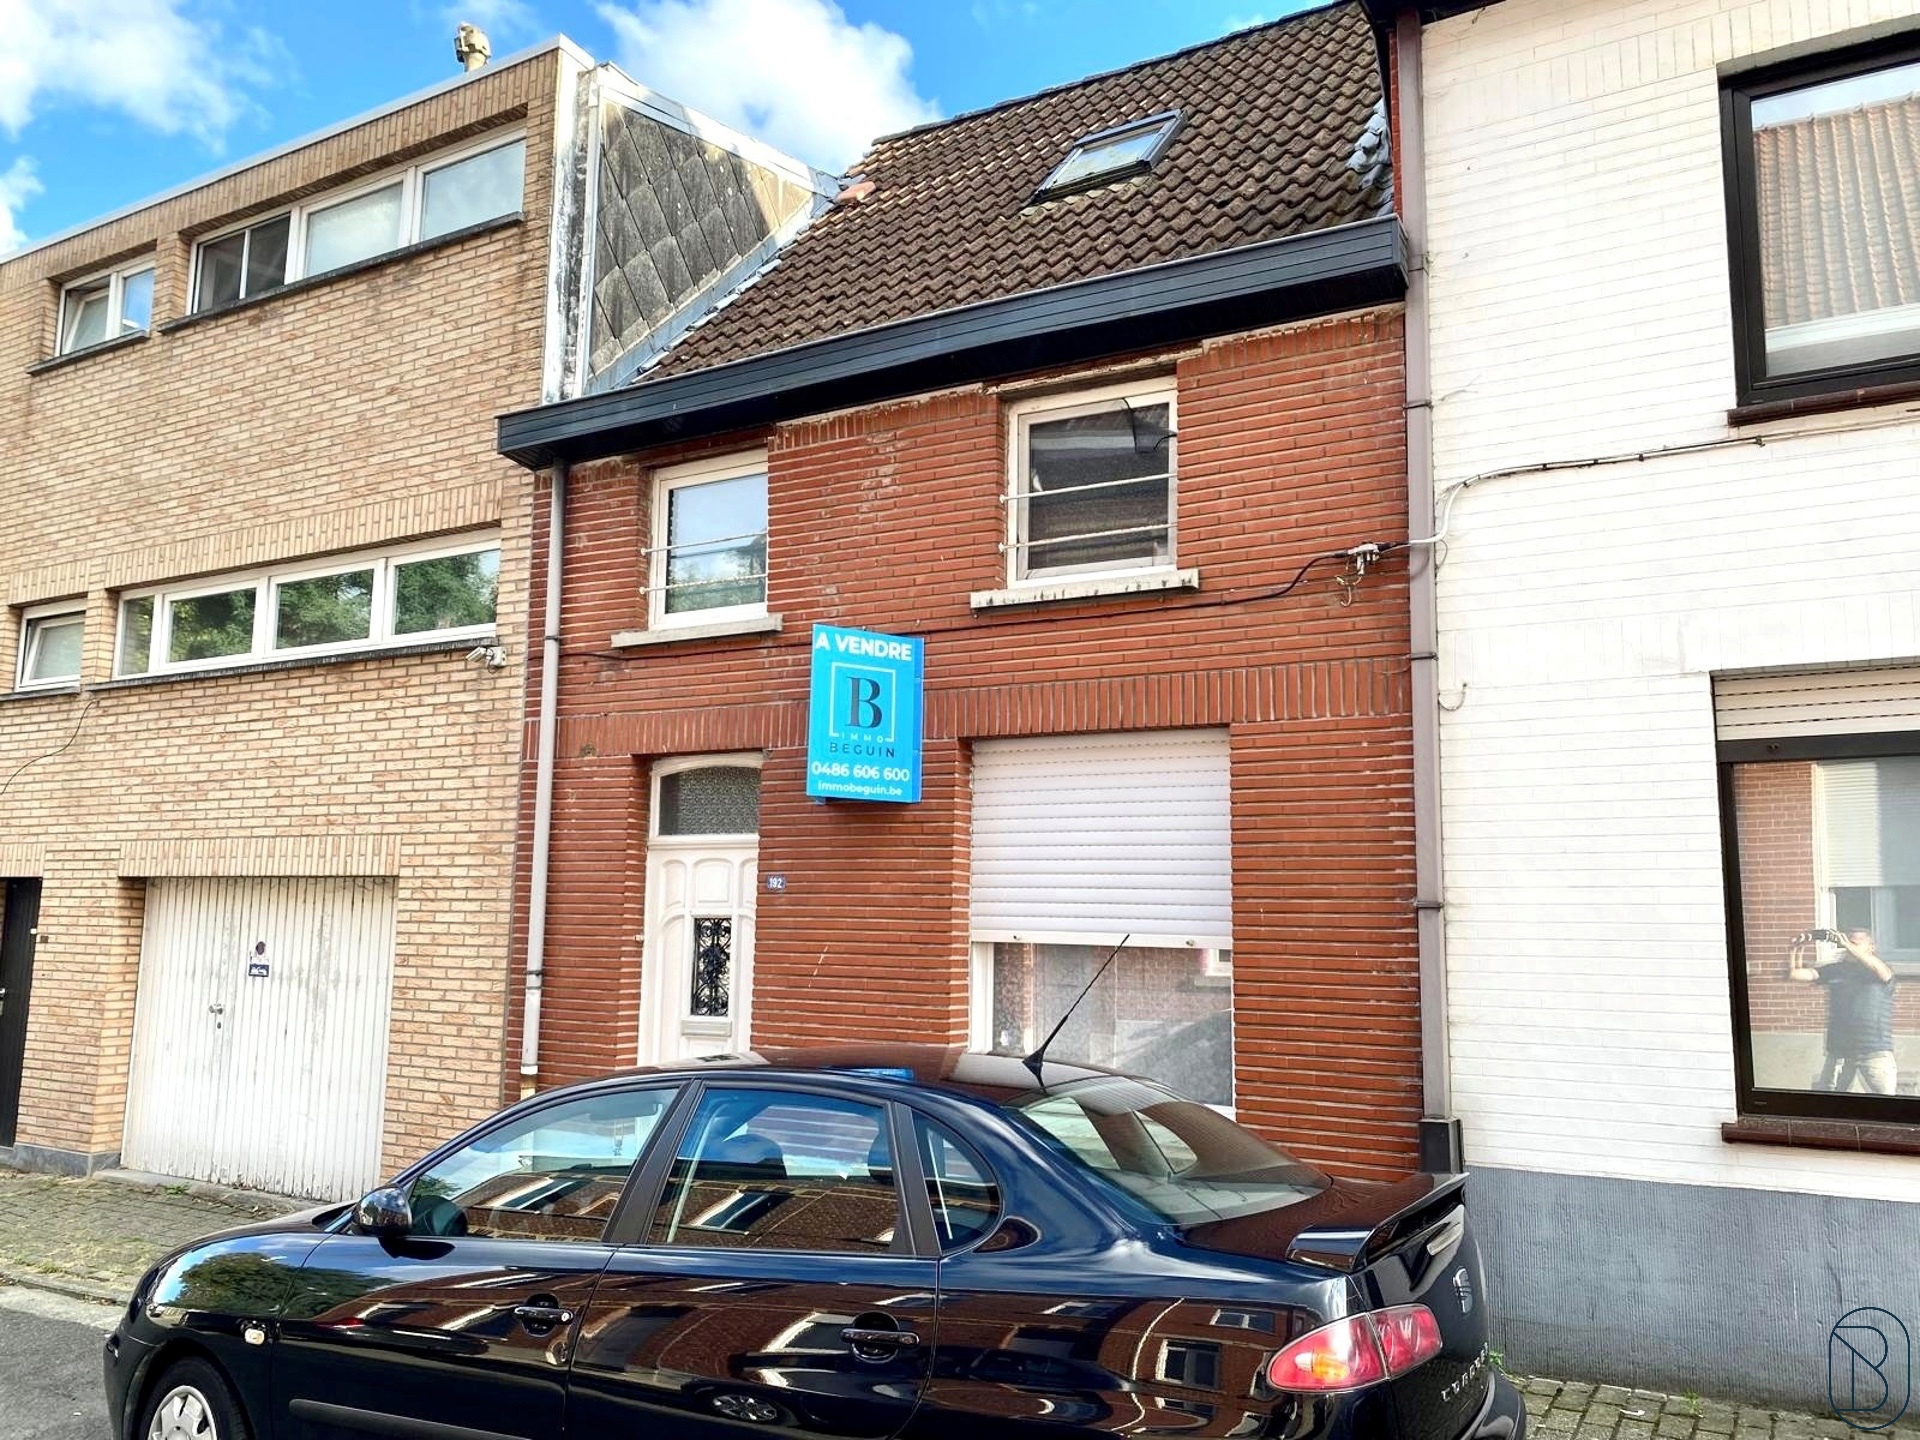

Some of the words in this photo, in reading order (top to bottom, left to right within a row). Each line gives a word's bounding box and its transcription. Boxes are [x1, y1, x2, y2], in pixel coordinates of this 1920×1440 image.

[815, 631, 831, 651] A
[834, 633, 913, 662] VENDRE
[845, 676, 883, 729] B
[841, 732, 884, 743] IMMO
[829, 742, 895, 758] BEGUIN
[811, 760, 850, 777] 0486
[853, 764, 880, 780] 606
[883, 767, 911, 782] 600
[818, 780, 903, 796] immobeguin.be
[769, 877, 783, 889] 192
